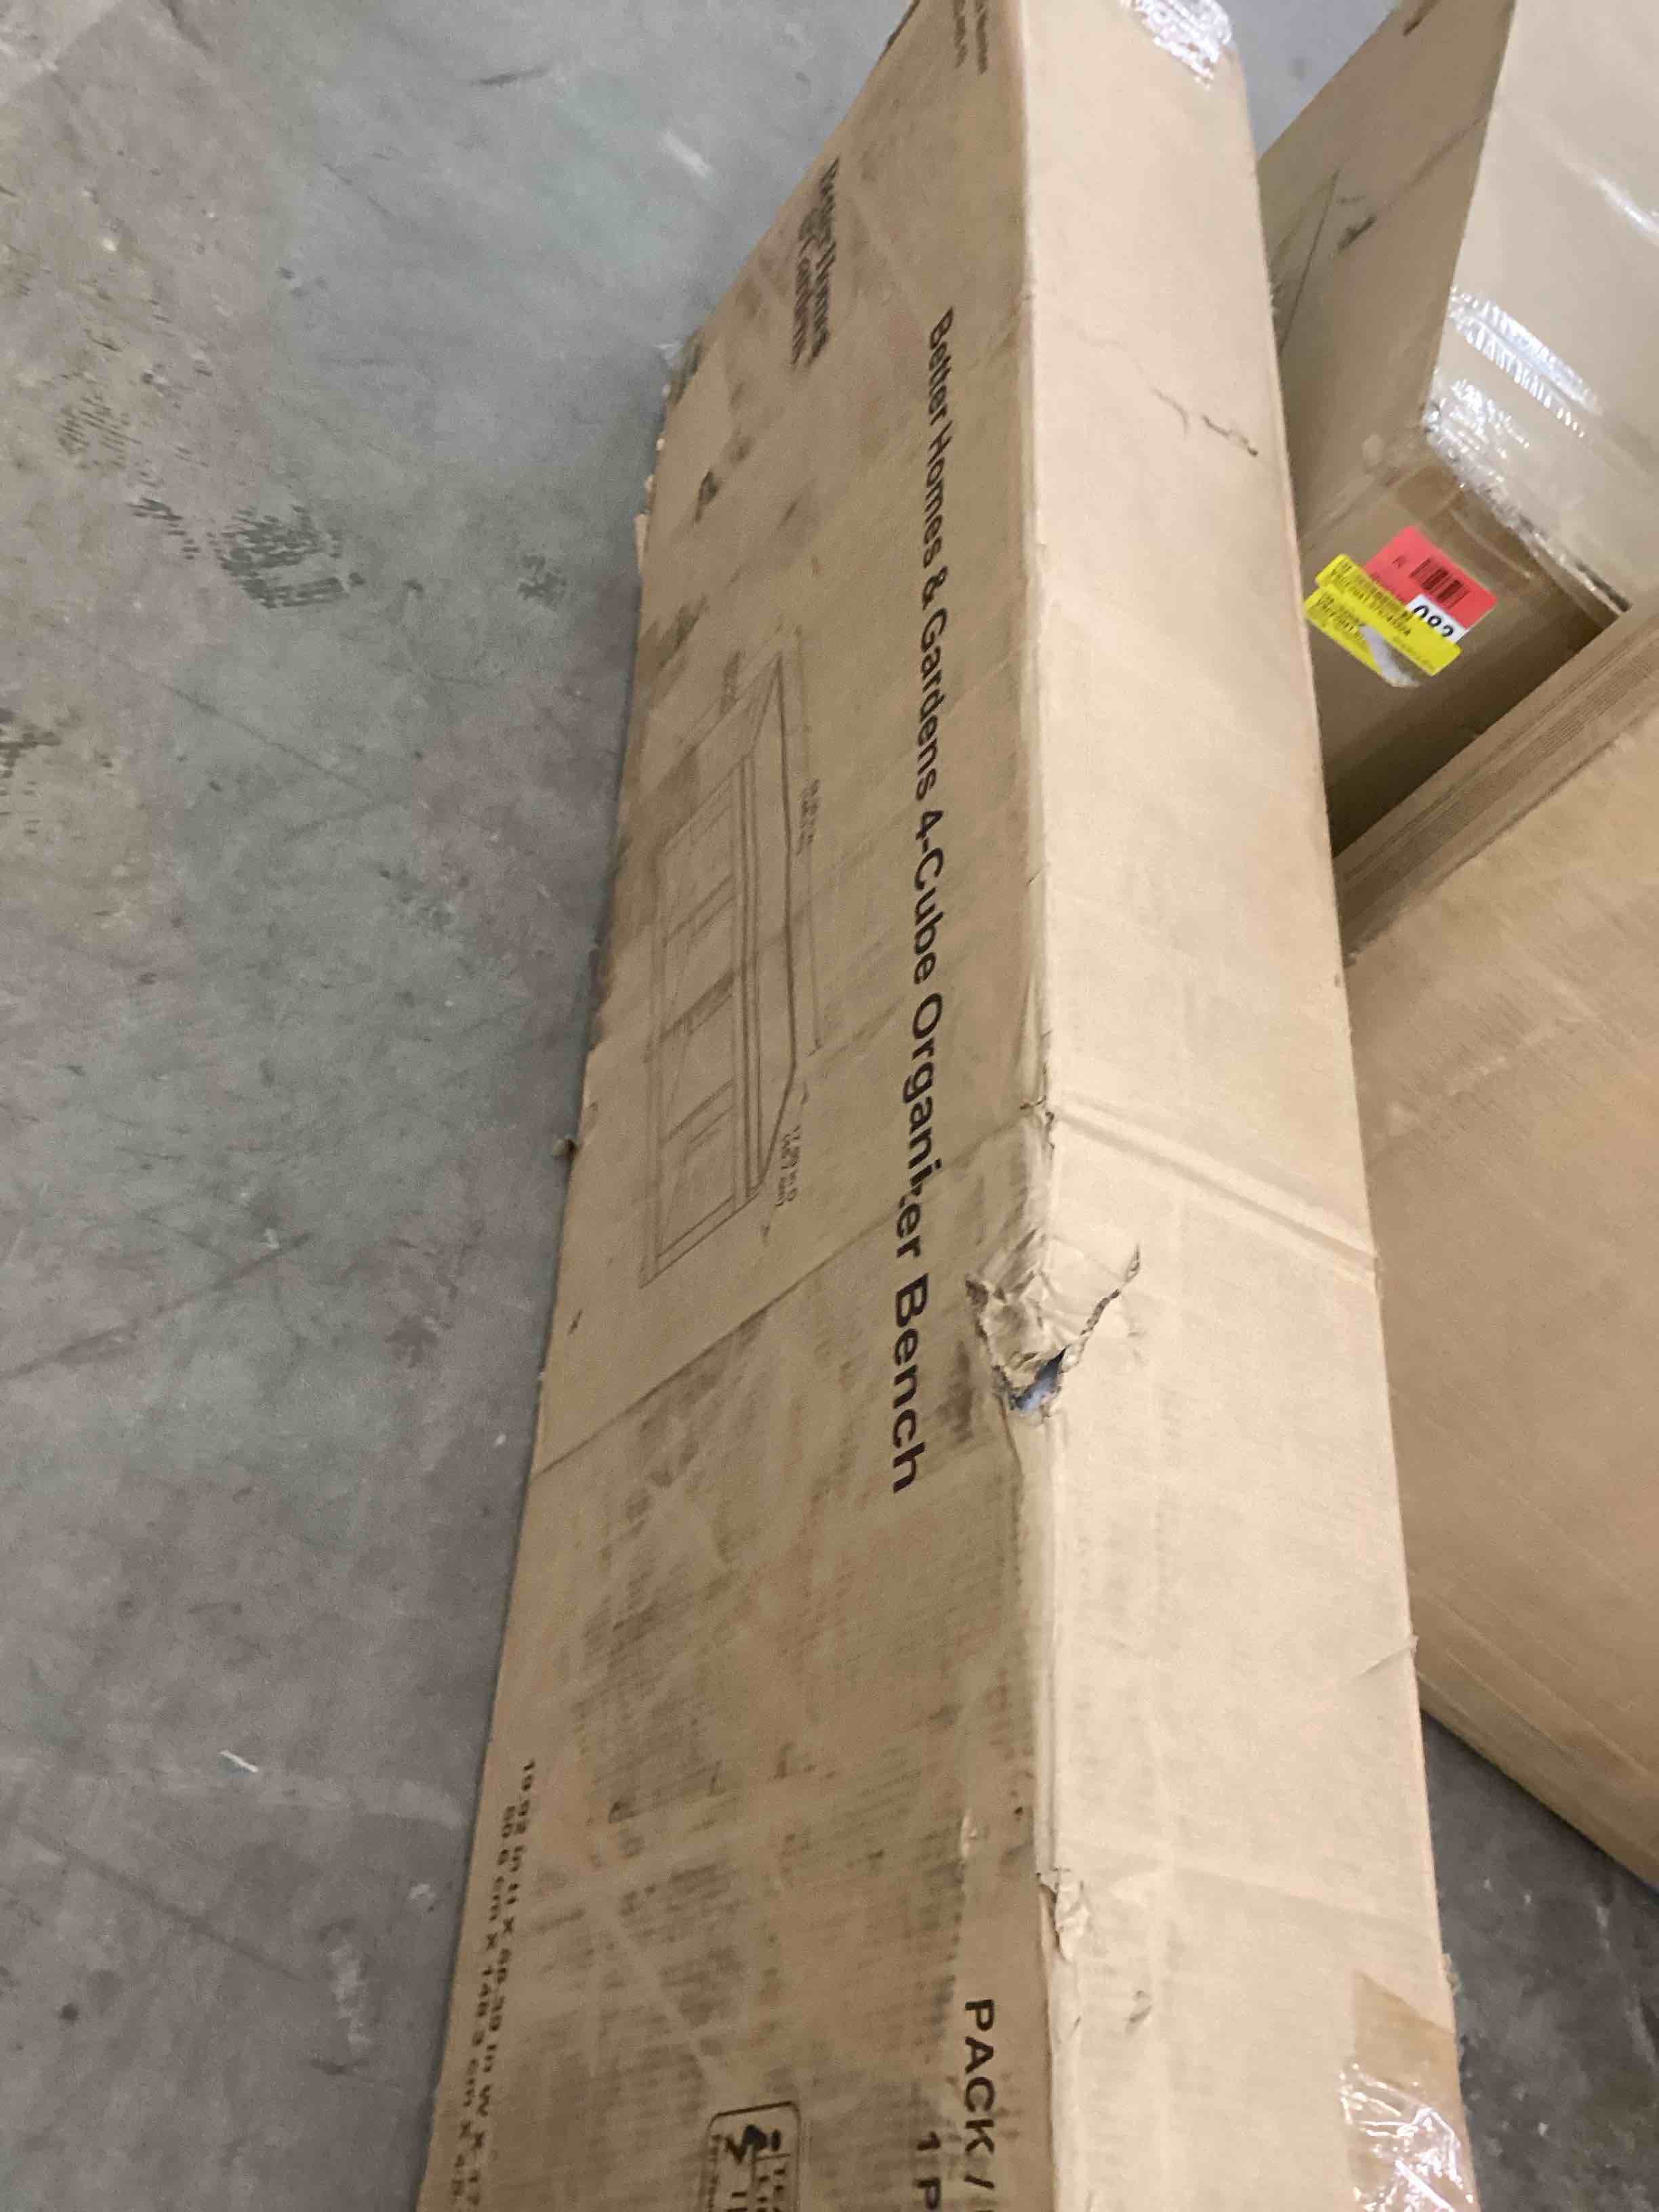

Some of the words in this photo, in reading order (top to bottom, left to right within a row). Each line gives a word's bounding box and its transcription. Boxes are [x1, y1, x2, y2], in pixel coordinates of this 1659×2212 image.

[928, 306, 954, 427] Better
[923, 419, 954, 570] Homes
[921, 565, 949, 611] &
[916, 607, 948, 802] Gardens
[913, 808, 945, 985] 4-Cube
[892, 1272, 930, 1494] Bench
[916, 2131, 941, 2152] 1
[964, 1999, 996, 2156] PACK
[963, 2173, 996, 2191] /
